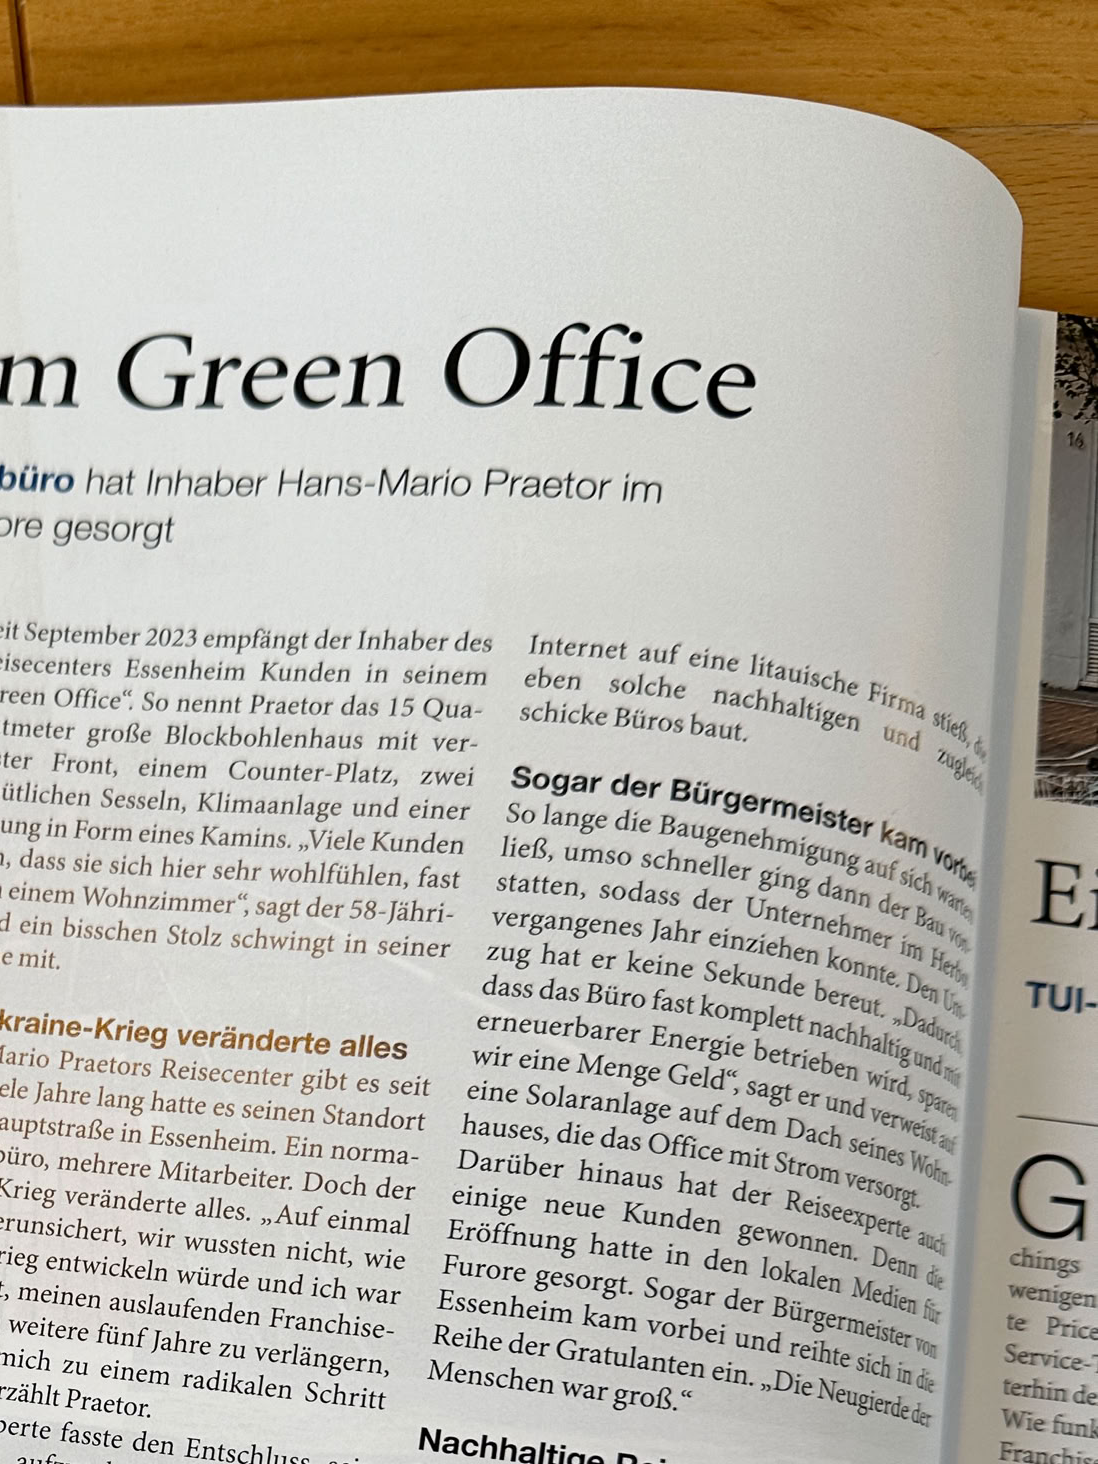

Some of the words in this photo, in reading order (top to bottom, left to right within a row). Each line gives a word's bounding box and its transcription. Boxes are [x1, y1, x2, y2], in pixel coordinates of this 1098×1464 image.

[117, 332, 404, 411] Green
[444, 322, 756, 419] Office
[1067, 431, 1084, 449] 16
[86, 467, 135, 495] hat
[147, 468, 268, 497] Inhaber
[278, 467, 472, 497] Hans-Mario
[484, 468, 612, 500] Praetor
[622, 473, 663, 504] im
[53, 516, 174, 550] gesorgt
[25, 622, 141, 648] September
[145, 627, 197, 647] 2023
[203, 628, 308, 655] empfängt
[314, 628, 352, 649] der
[358, 629, 449, 651] Inhaber
[454, 630, 492, 652] des
[520, 701, 608, 726] schicke
[614, 707, 684, 733] Büros
[690, 713, 747, 742] baut.
[511, 765, 603, 796] Sogar
[611, 773, 662, 798] der
[670, 778, 874, 837] Bürgermeister
[881, 821, 928, 858] kam
[178, 1026, 331, 1055] veränderte
[340, 1034, 408, 1060] alles
[120, 1123, 141, 1143] in
[149, 1125, 276, 1154] Essenheim.
[284, 1136, 322, 1158] Ein
[331, 1145, 419, 1165] norma-
[1010, 1247, 1081, 1278] chings
[1007, 1314, 1027, 1331] te
[1003, 1379, 1068, 1402] terhin
[1001, 1408, 1046, 1432] Wie
